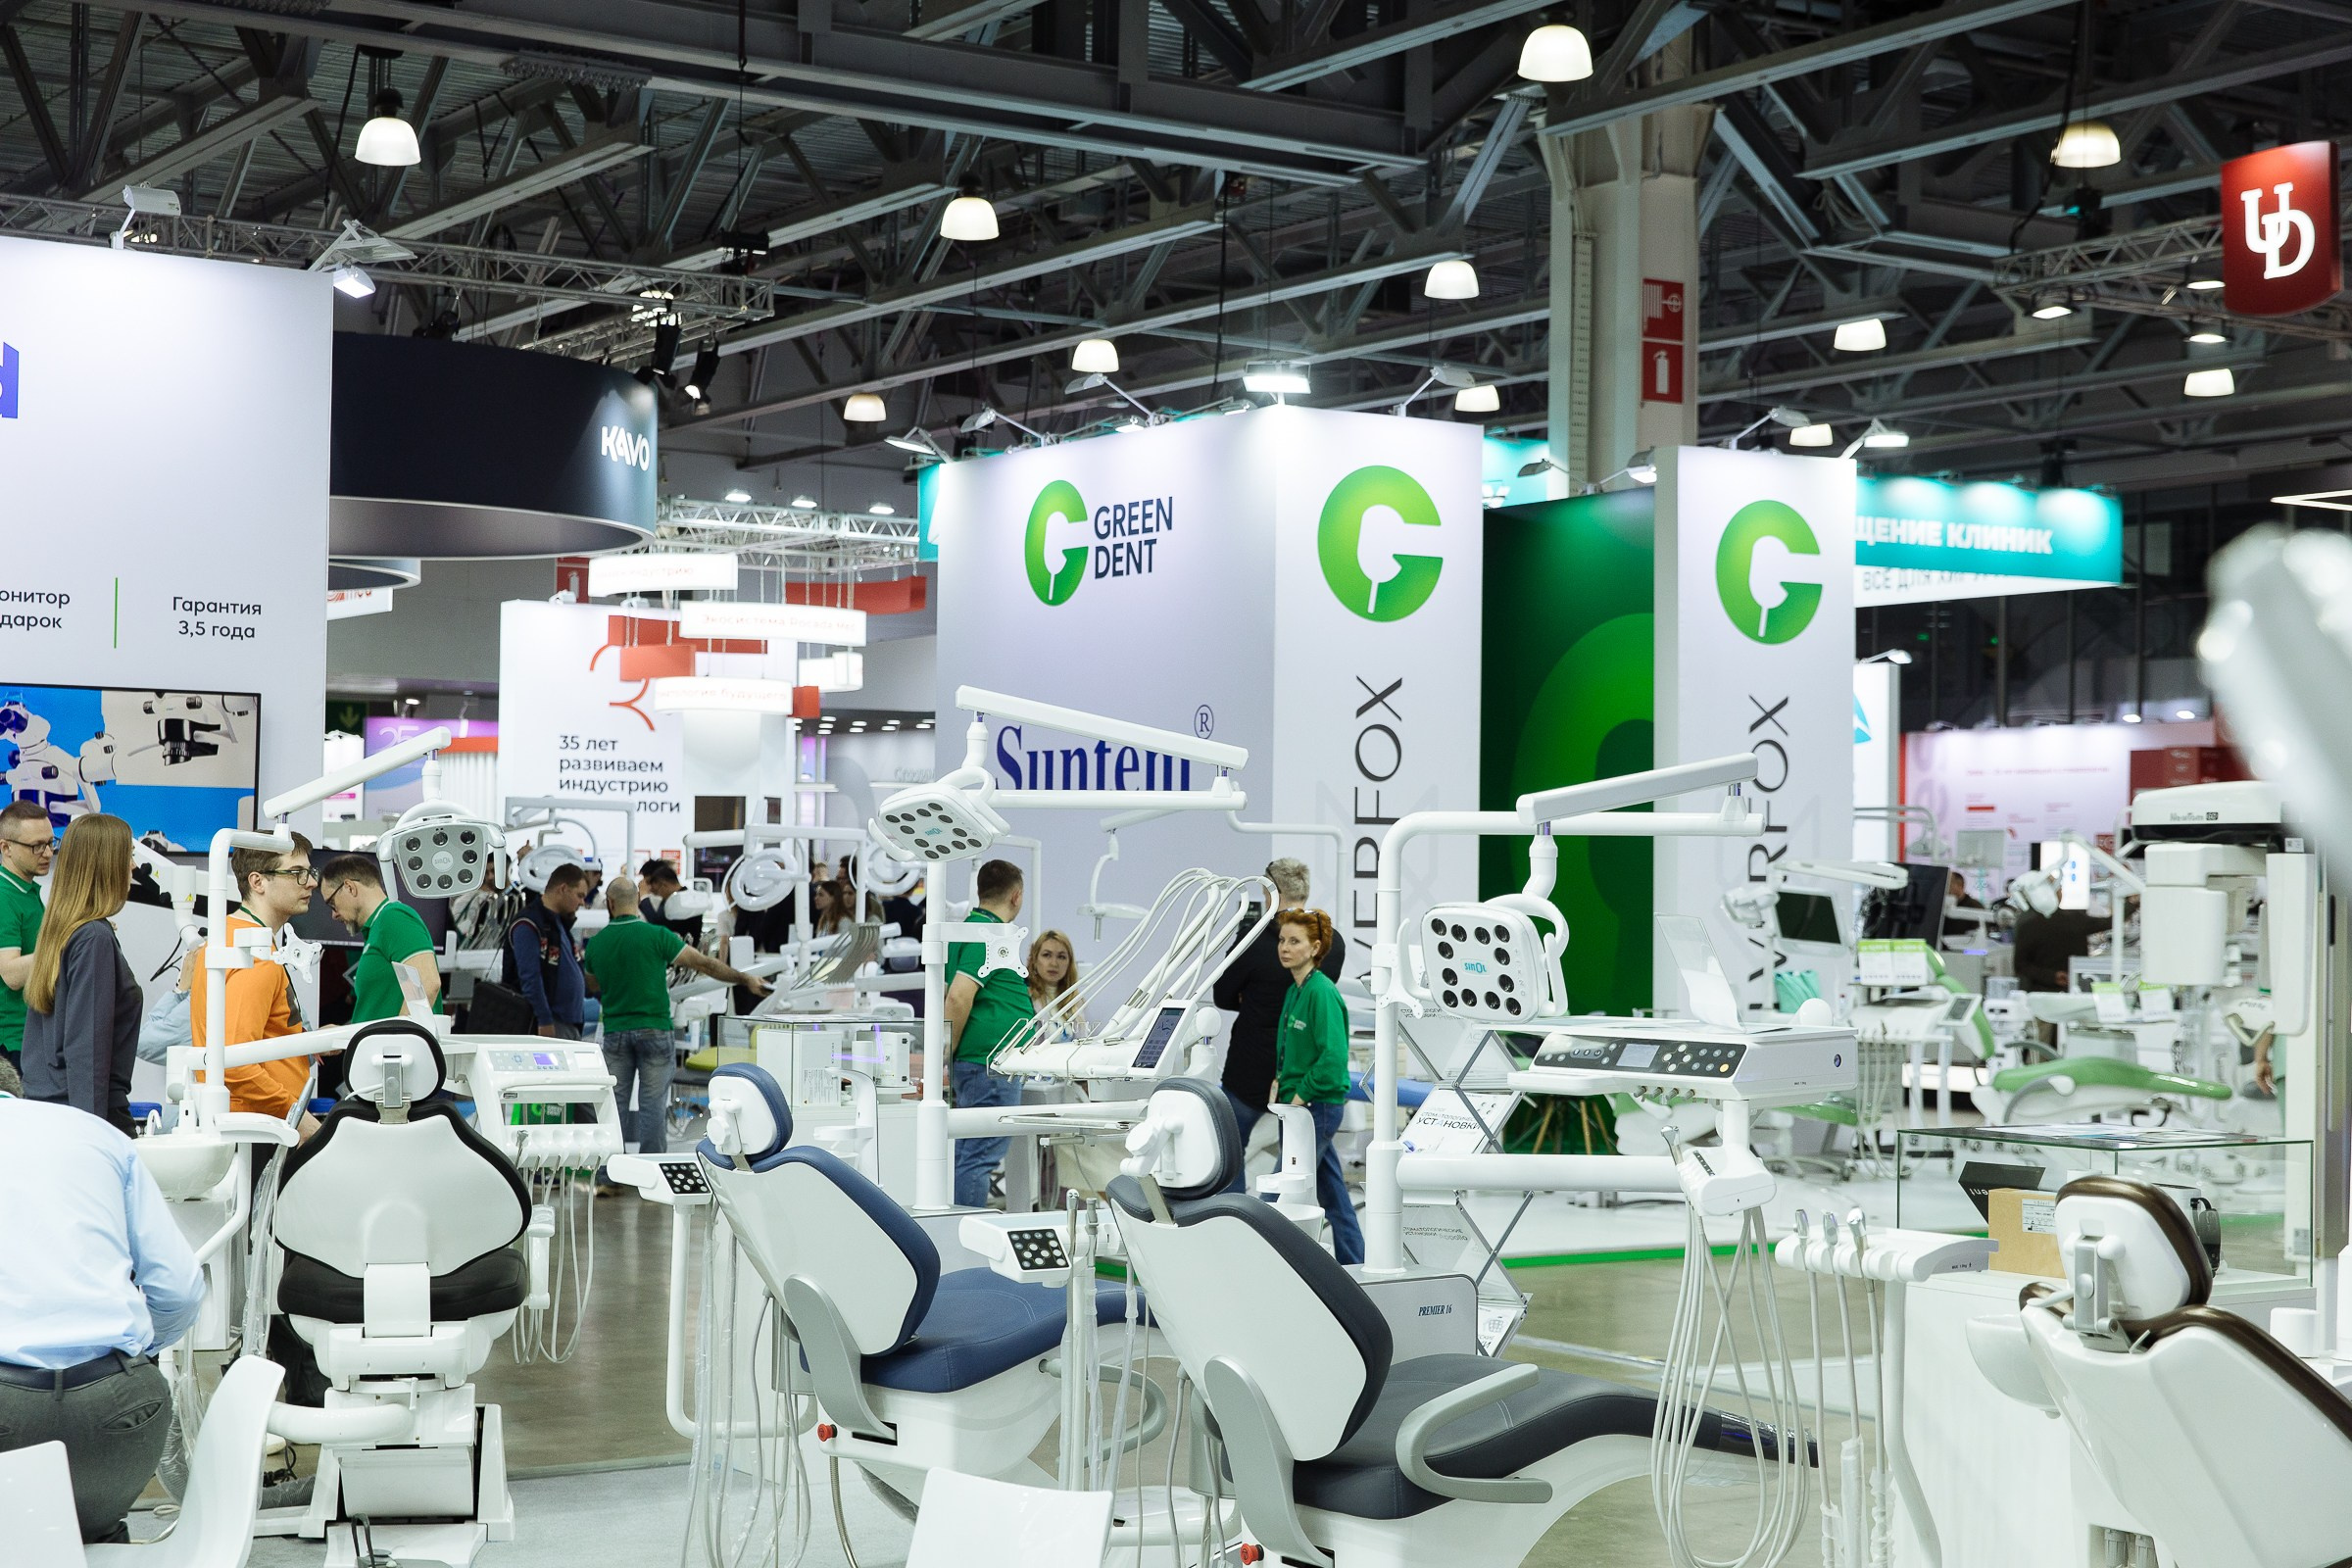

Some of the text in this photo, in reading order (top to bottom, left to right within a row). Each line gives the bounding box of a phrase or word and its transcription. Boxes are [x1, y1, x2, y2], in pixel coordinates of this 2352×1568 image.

[1094, 496, 1173, 540] GREEN
[1946, 522, 2054, 555] КЛИНИК
[1095, 538, 1157, 580] DENT
[172, 596, 262, 616] Гарантия
[178, 620, 256, 641] 3,5 года
[559, 735, 618, 751] 35 лет
[559, 759, 663, 773] развиваем
[559, 779, 668, 795] индустрию
[1416, 1117, 1481, 1130] УСТАНОВКИ
[1418, 1304, 1452, 1316] PREMIER 16
